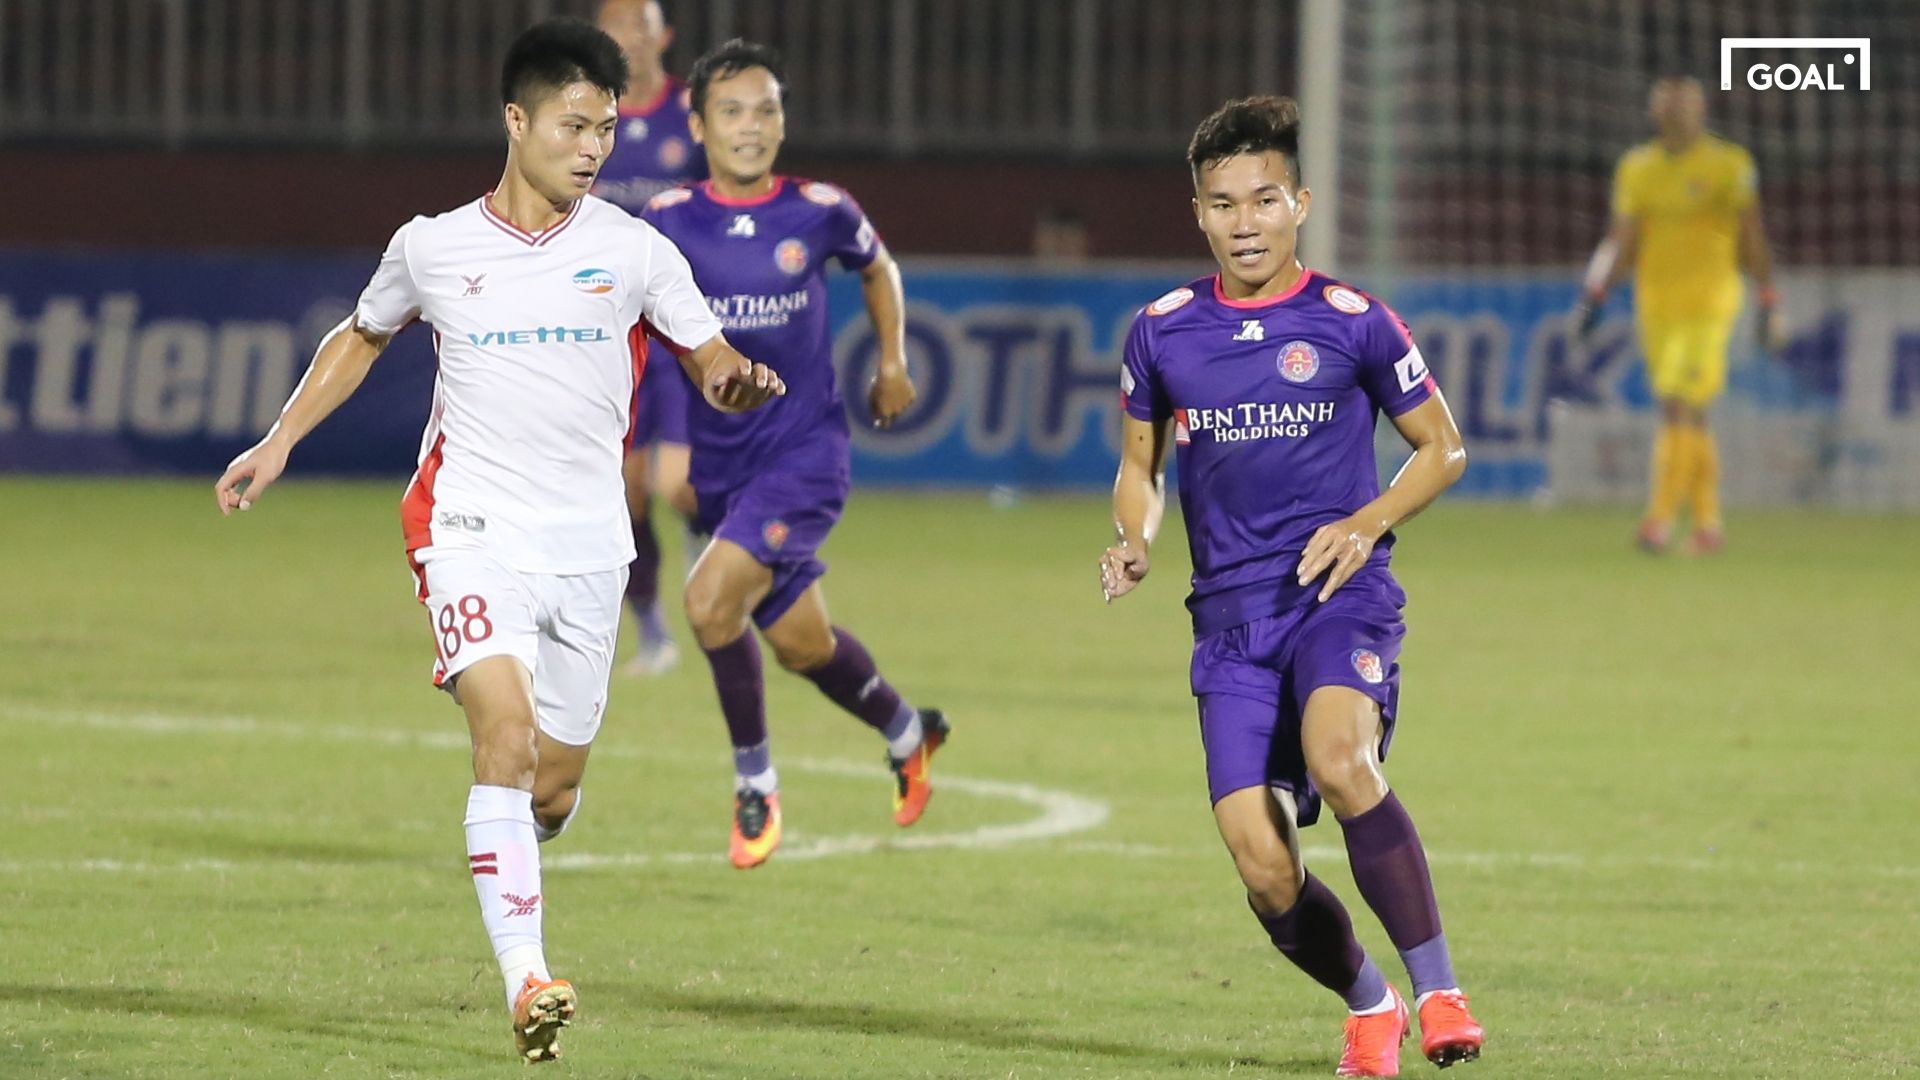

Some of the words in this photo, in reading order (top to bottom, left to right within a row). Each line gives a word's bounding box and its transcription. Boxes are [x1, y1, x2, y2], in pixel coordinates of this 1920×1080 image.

[731, 289, 809, 316] THANH
[716, 312, 789, 329] OLDINGS
[1187, 407, 1233, 431] BEN
[1238, 402, 1334, 426] THANH
[1214, 423, 1309, 443] HOLDINGS
[438, 594, 493, 660] 88
